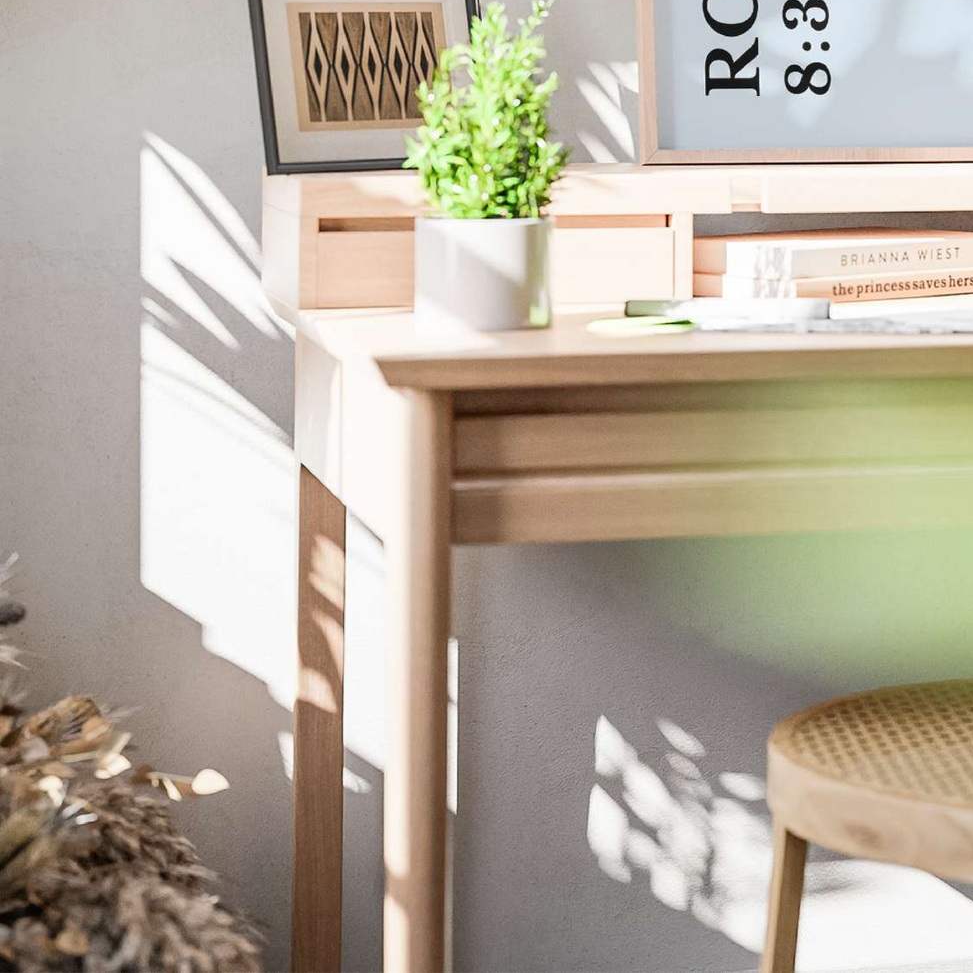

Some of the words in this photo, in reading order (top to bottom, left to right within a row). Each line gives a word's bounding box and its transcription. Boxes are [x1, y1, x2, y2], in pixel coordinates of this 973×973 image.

[840, 251, 910, 267] BRIANNA
[917, 246, 961, 261] WIEST
[832, 282, 854, 296] the
[856, 280, 911, 298] princess
[912, 278, 947, 290] saves
